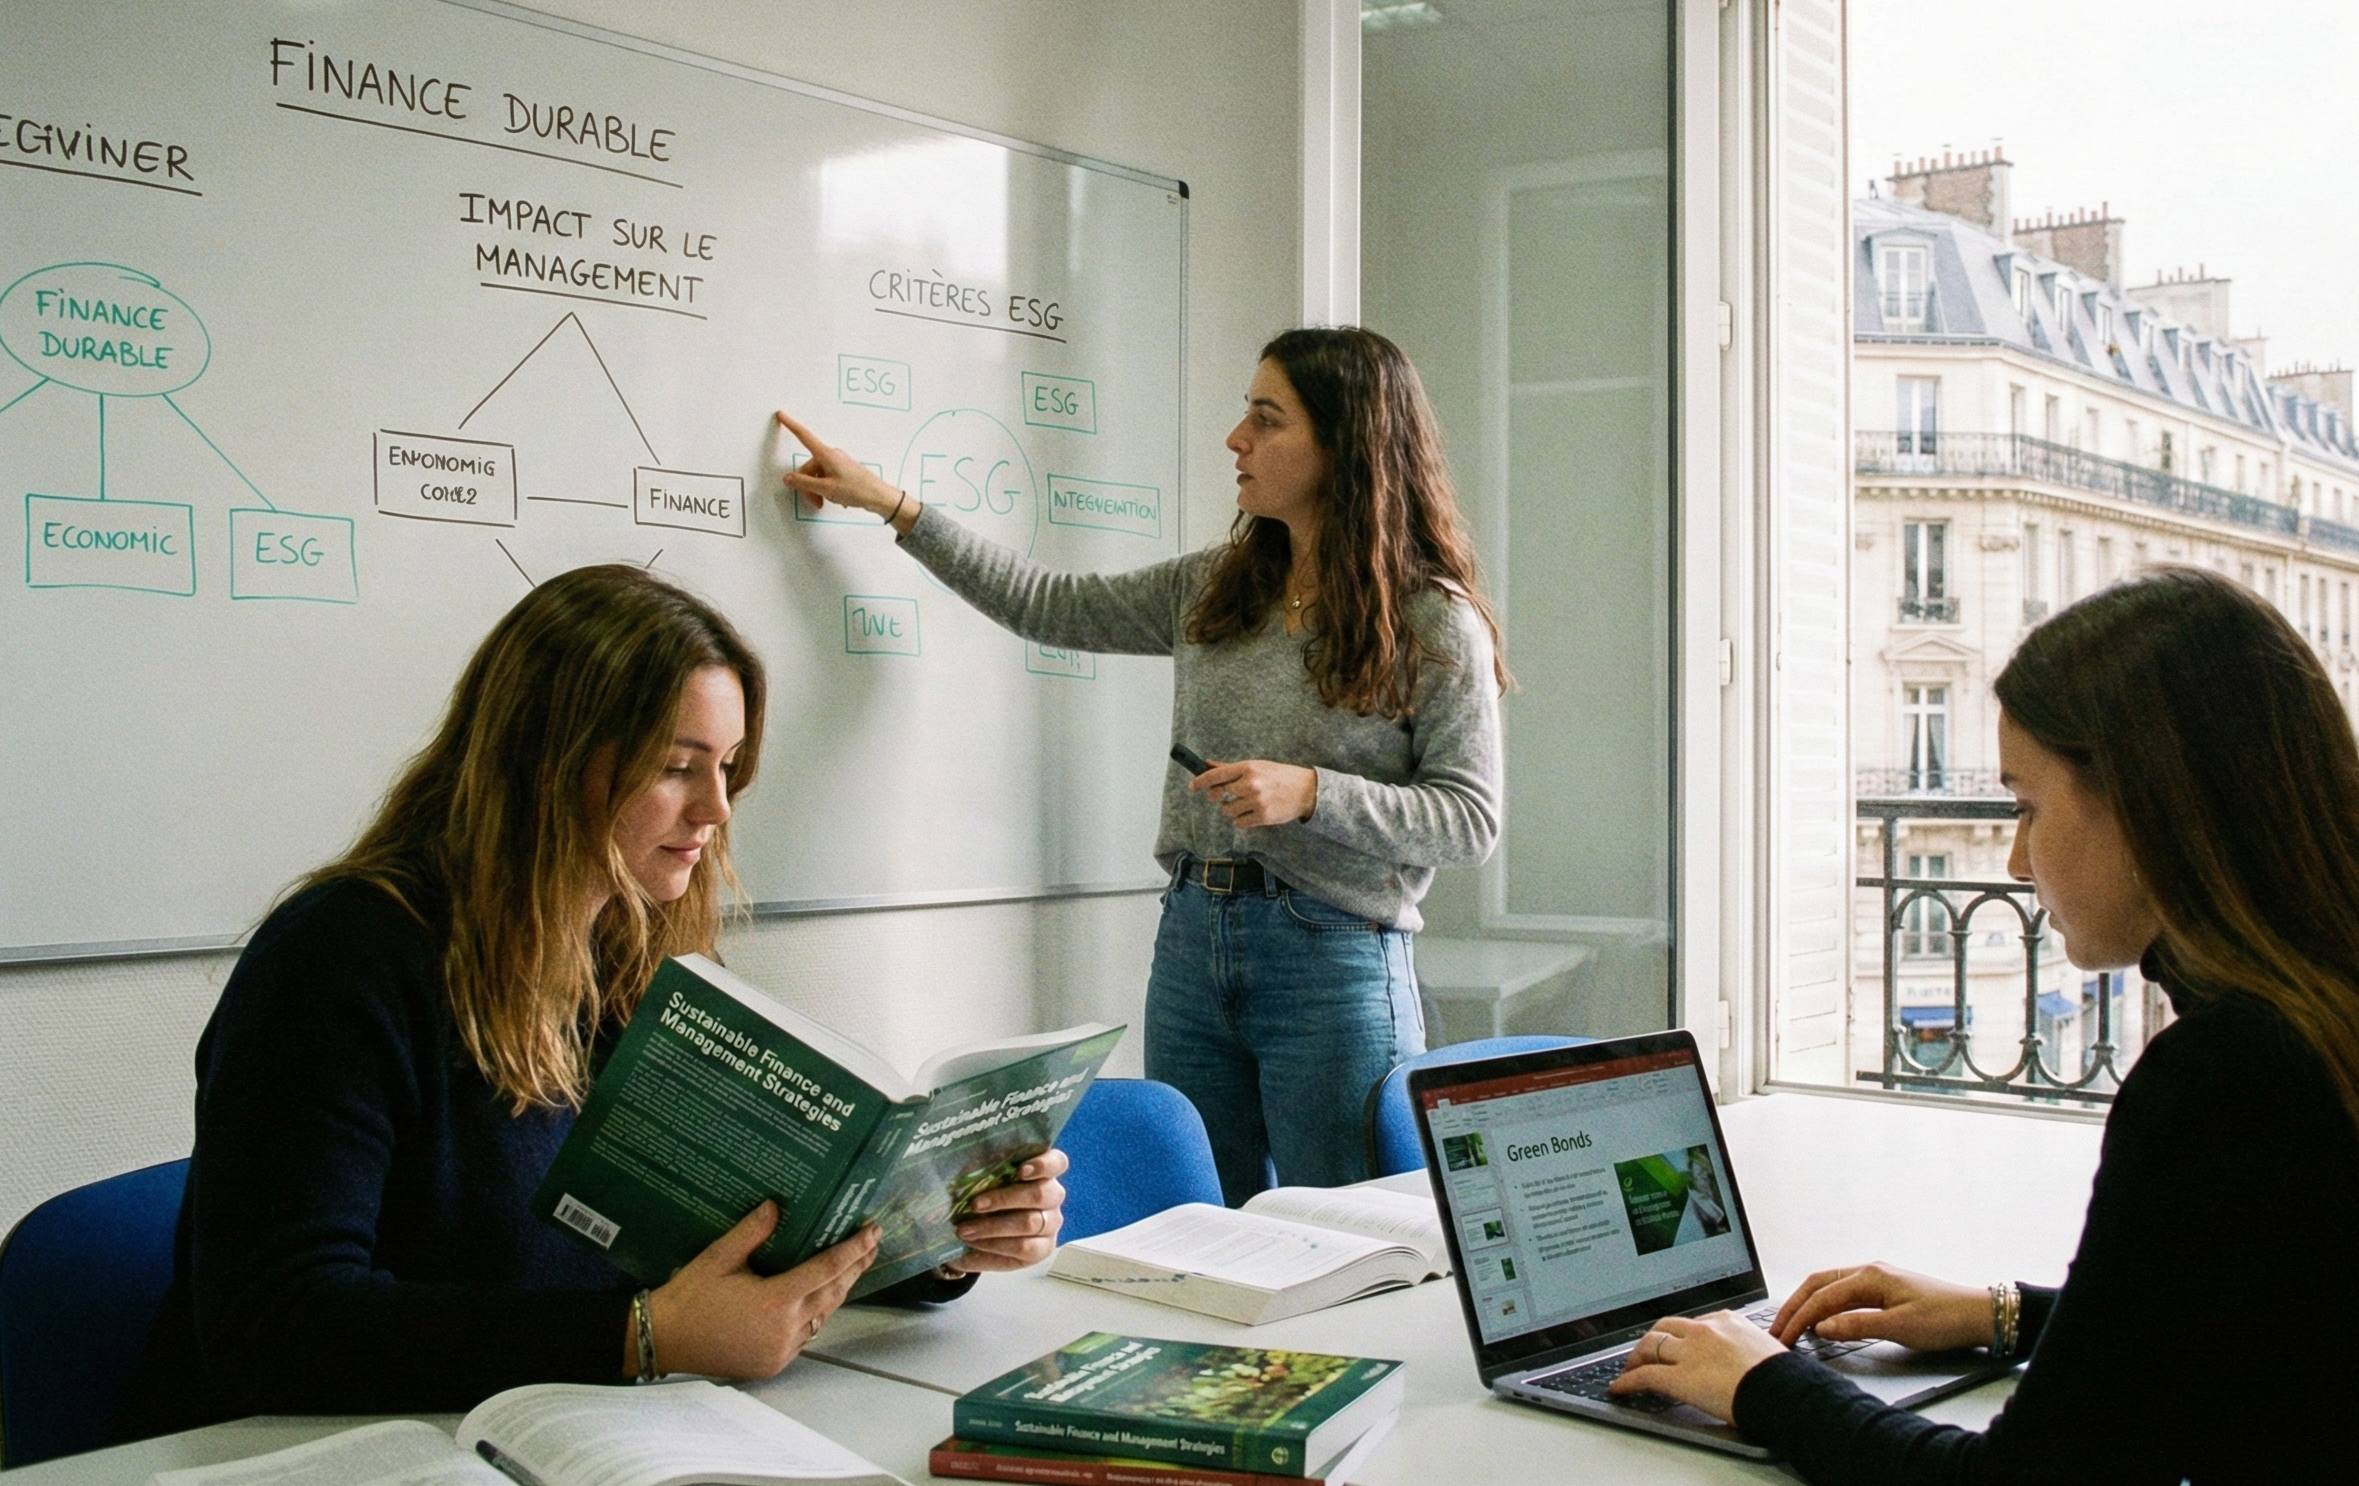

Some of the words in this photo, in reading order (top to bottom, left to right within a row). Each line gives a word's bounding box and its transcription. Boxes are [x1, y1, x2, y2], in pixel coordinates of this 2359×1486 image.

[270, 37, 472, 119] FINANCE
[503, 92, 677, 162] DURABLE
[459, 192, 592, 239] IMPACT
[612, 218, 668, 254] SUR
[683, 232, 718, 261] LE
[476, 243, 704, 303] MANAGEMENT
[35, 288, 169, 331] FINANCE
[868, 268, 992, 317] CRITÈRES
[1008, 295, 1064, 331] ESG
[38, 330, 174, 369] DURABLE
[845, 367, 896, 397] ESG
[1034, 385, 1080, 416] ESG
[650, 488, 731, 519] FINANCE
[919, 453, 1022, 516] ESG
[43, 522, 178, 556] ECONOMIC
[256, 532, 325, 567] ESG
[660, 1007, 763, 1082] Management
[762, 1073, 842, 1132] Strategies
[668, 991, 760, 1057] Sustainable
[759, 1048, 822, 1097] Finance
[822, 1091, 856, 1118] and
[1507, 1141, 1550, 1162] Green
[1551, 1130, 1593, 1153] Bonds
